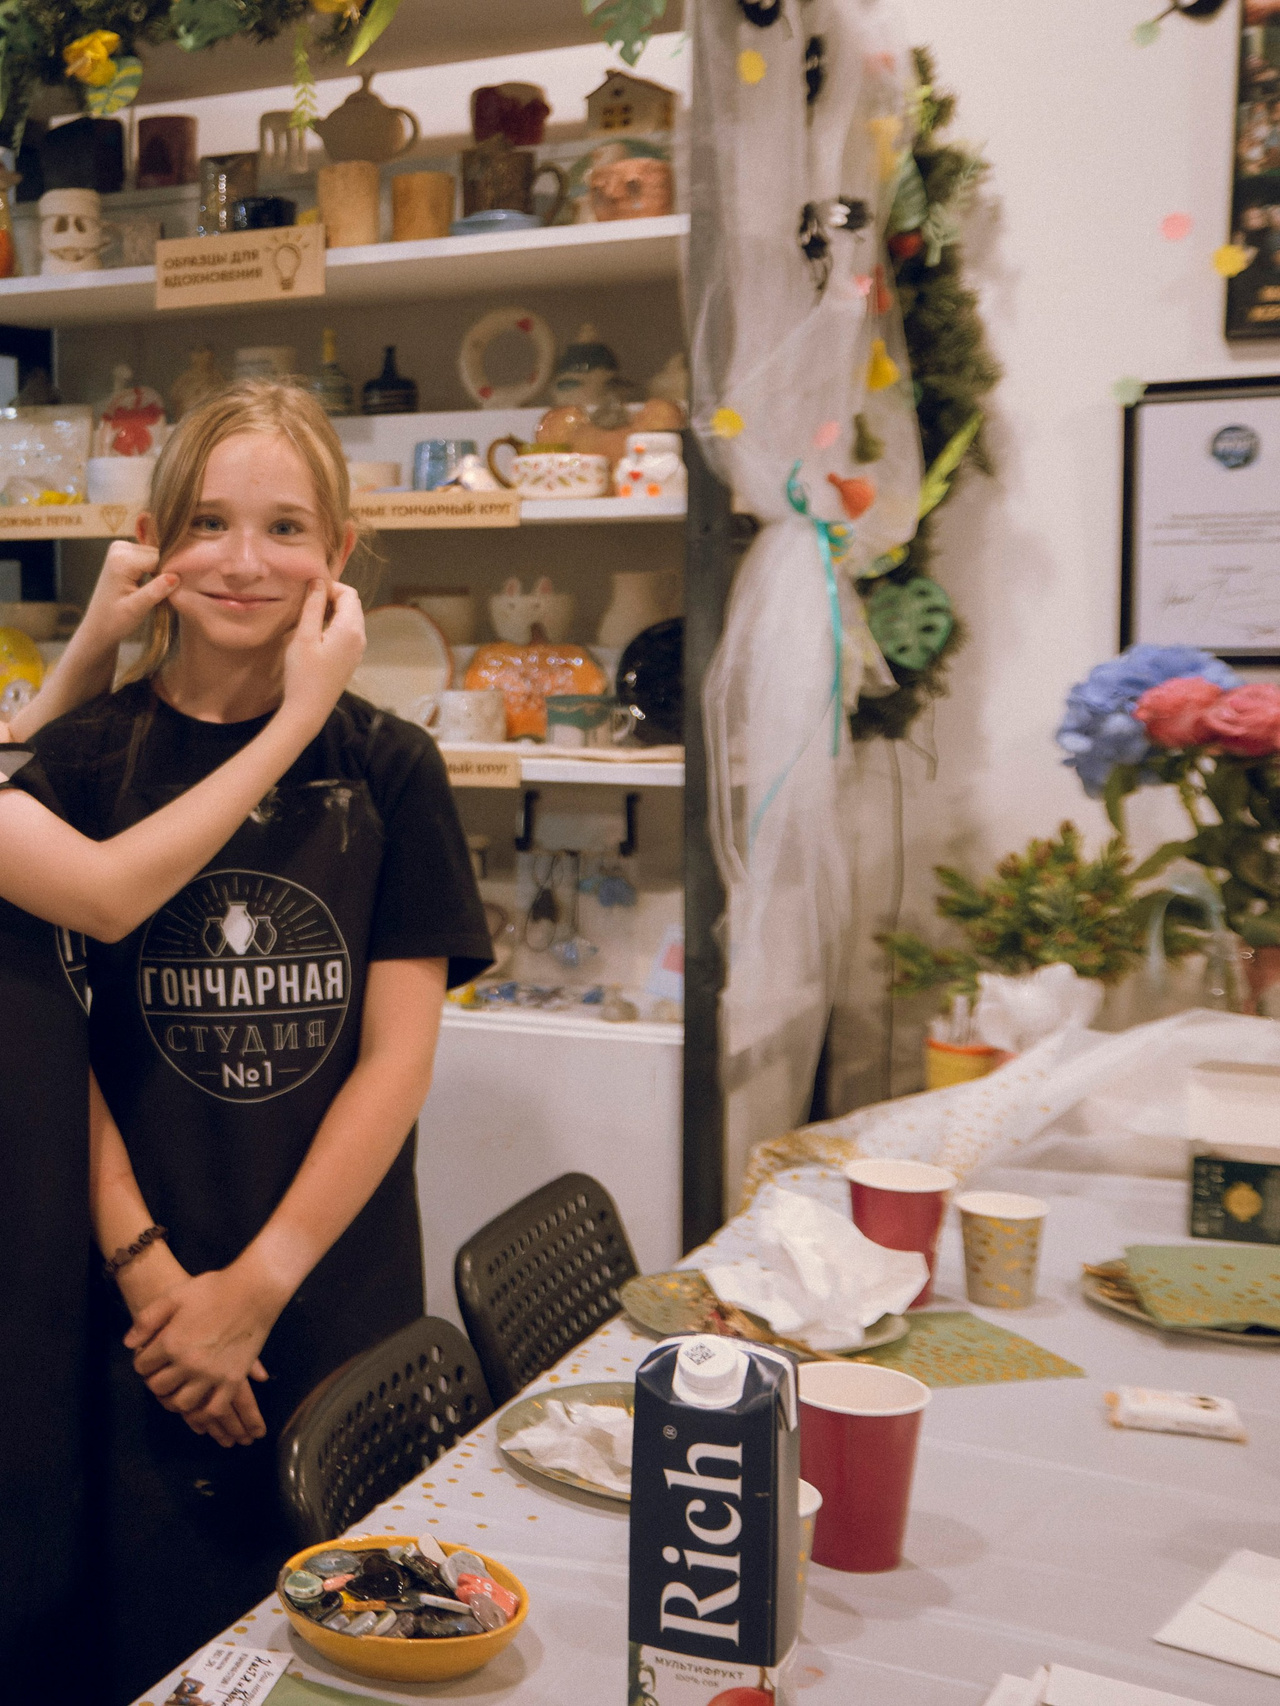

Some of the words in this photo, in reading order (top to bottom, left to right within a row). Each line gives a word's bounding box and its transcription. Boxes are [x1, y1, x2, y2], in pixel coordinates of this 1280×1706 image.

[163, 252, 228, 270] ОБРАЗЦЫ
[231, 249, 261, 265] ДЛЯ
[163, 267, 263, 289] ВДОХНОВЕНИЯ
[392, 501, 476, 517] ГОНЧАРНЫЙ
[480, 501, 512, 515] КРУГ
[143, 960, 344, 1007] ГОНЧАРНАЯ
[166, 1019, 327, 1056] СТУДИЯ
[222, 1061, 273, 1088] №1
[660, 1441, 743, 1648] Rich
[654, 1654, 745, 1681] МУЛЬТИФРУКТ
